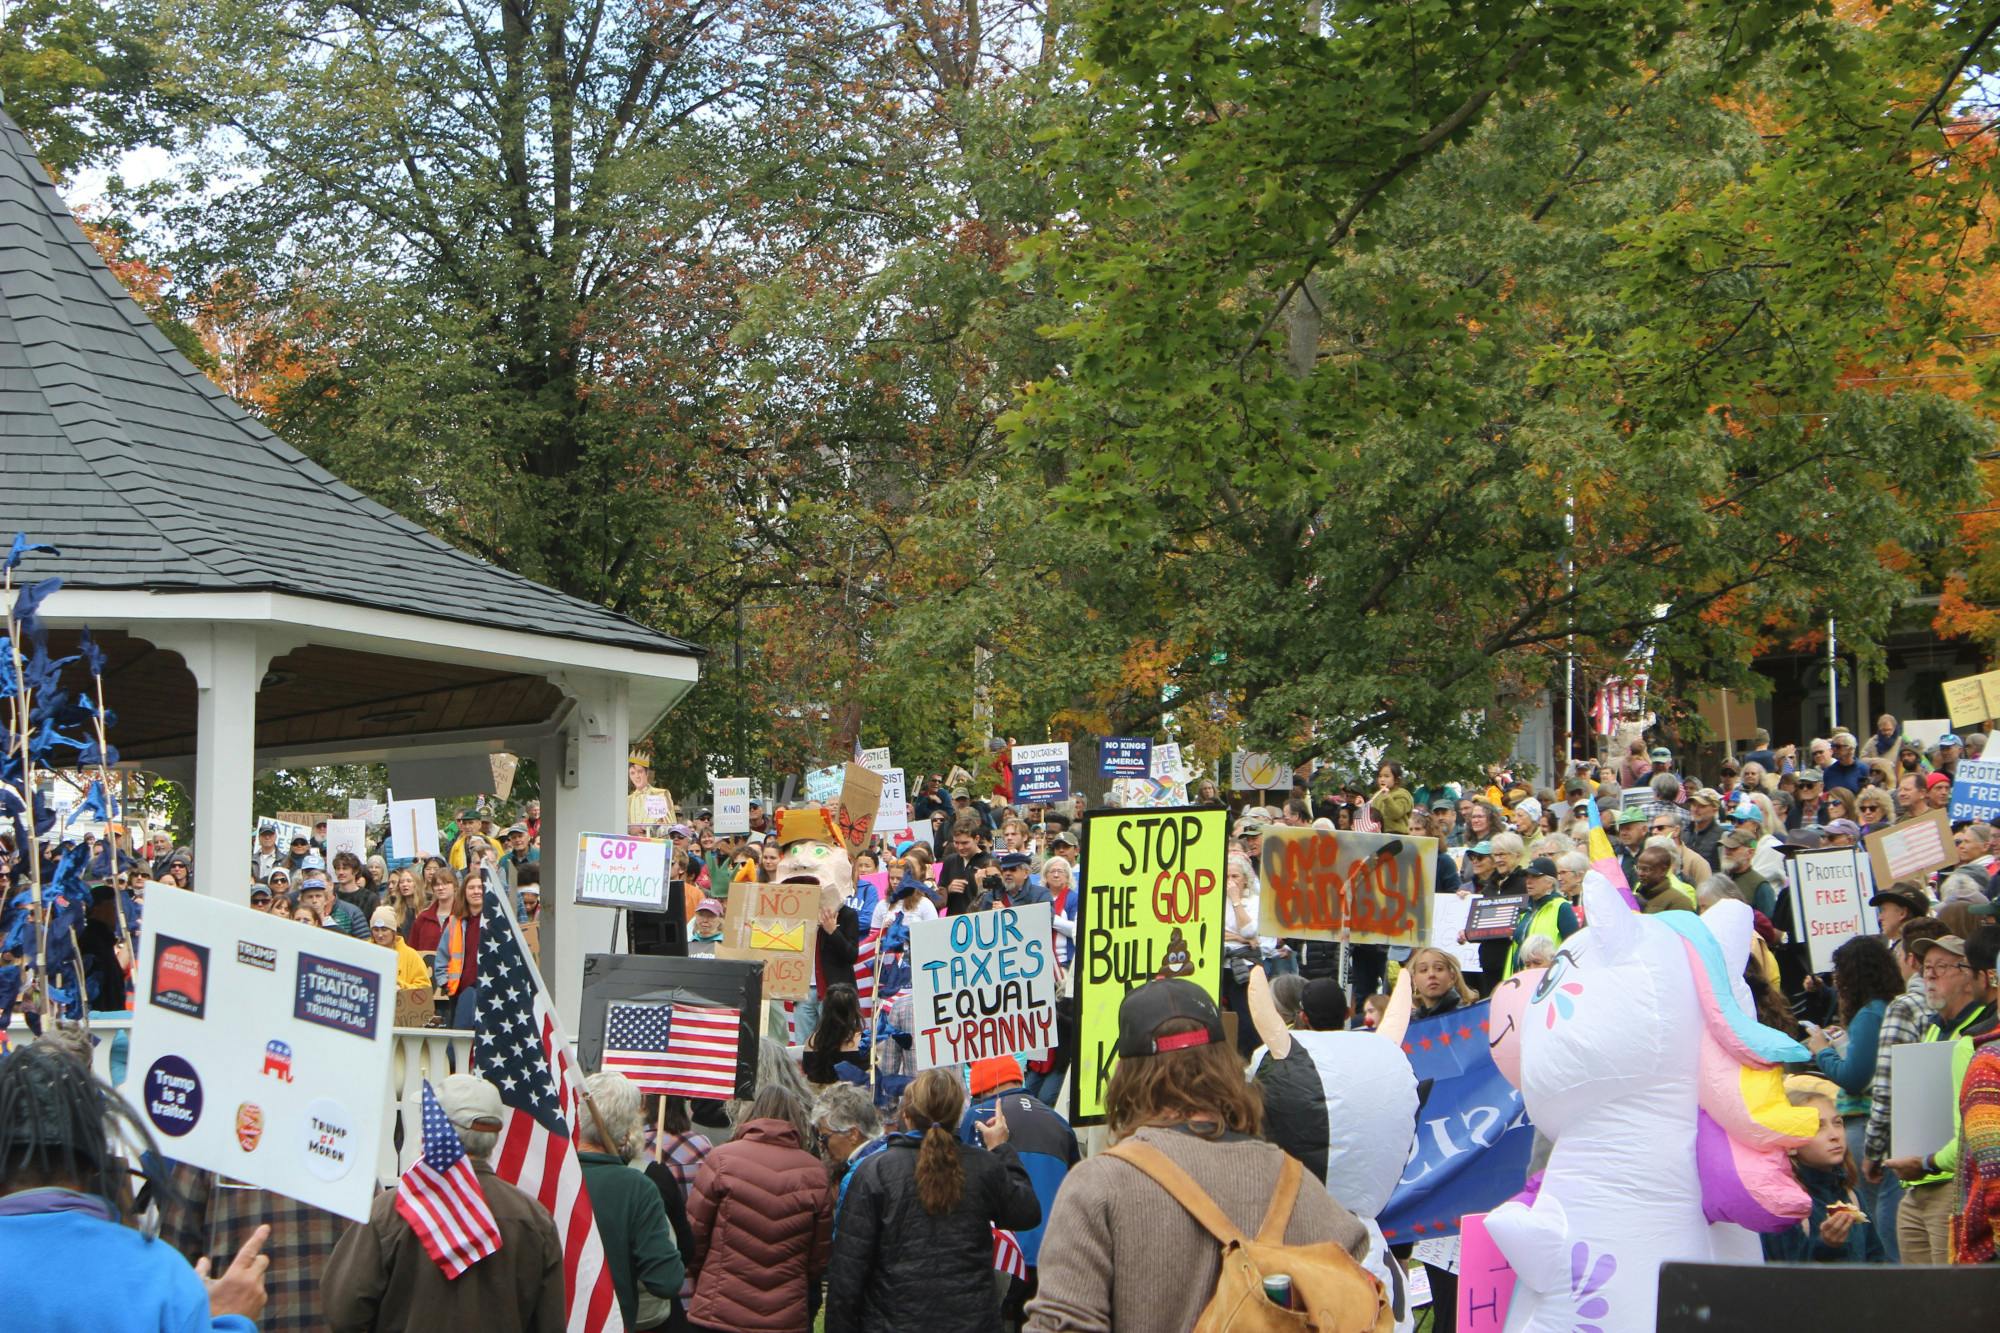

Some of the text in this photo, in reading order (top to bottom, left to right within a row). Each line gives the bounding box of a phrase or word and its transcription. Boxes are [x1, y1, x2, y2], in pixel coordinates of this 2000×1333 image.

[865, 750, 888, 761] STICE
[1018, 747, 1064, 760] NO DICTATORS
[1105, 741, 1146, 750] NO KINGS
[1018, 765, 1062, 776] NO KINGS
[1106, 758, 1144, 766] AMERICA
[882, 774, 903, 784] SIST
[1020, 781, 1060, 791] AMERICA
[720, 787, 746, 797] HUMAN
[884, 788, 900, 798] VE
[1969, 785, 2000, 802] FRE
[724, 805, 740, 814] KIND
[600, 840, 638, 860] GOP
[1117, 815, 1202, 876] STOP
[1286, 834, 1339, 880] NO
[1806, 862, 1854, 881] PROTECT
[585, 872, 660, 897] HYPOCRACY
[759, 893, 801, 916] NO
[1815, 888, 1848, 906] FREE
[1092, 885, 1137, 930] THE
[950, 908, 1024, 953] OUR
[1811, 914, 1858, 936] SPEECH!
[240, 942, 276, 960] TRUMP
[316, 964, 363, 984] Nothing says
[763, 960, 805, 982] NGS
[922, 940, 1044, 994] TAXES
[308, 973, 368, 1003] TRAITOR
[314, 993, 360, 1013] quite like a
[933, 980, 1046, 1026] EQUAL
[306, 1002, 366, 1028] TRUMP FLAG
[921, 1006, 1052, 1066] TYRANNY
[154, 1069, 196, 1094] Trump
[162, 1086, 186, 1104] is a
[152, 1100, 194, 1122] traitor.
[312, 1117, 348, 1138] TRUMP
[308, 1140, 344, 1162] MORON
[328, 1136, 335, 1146] A
